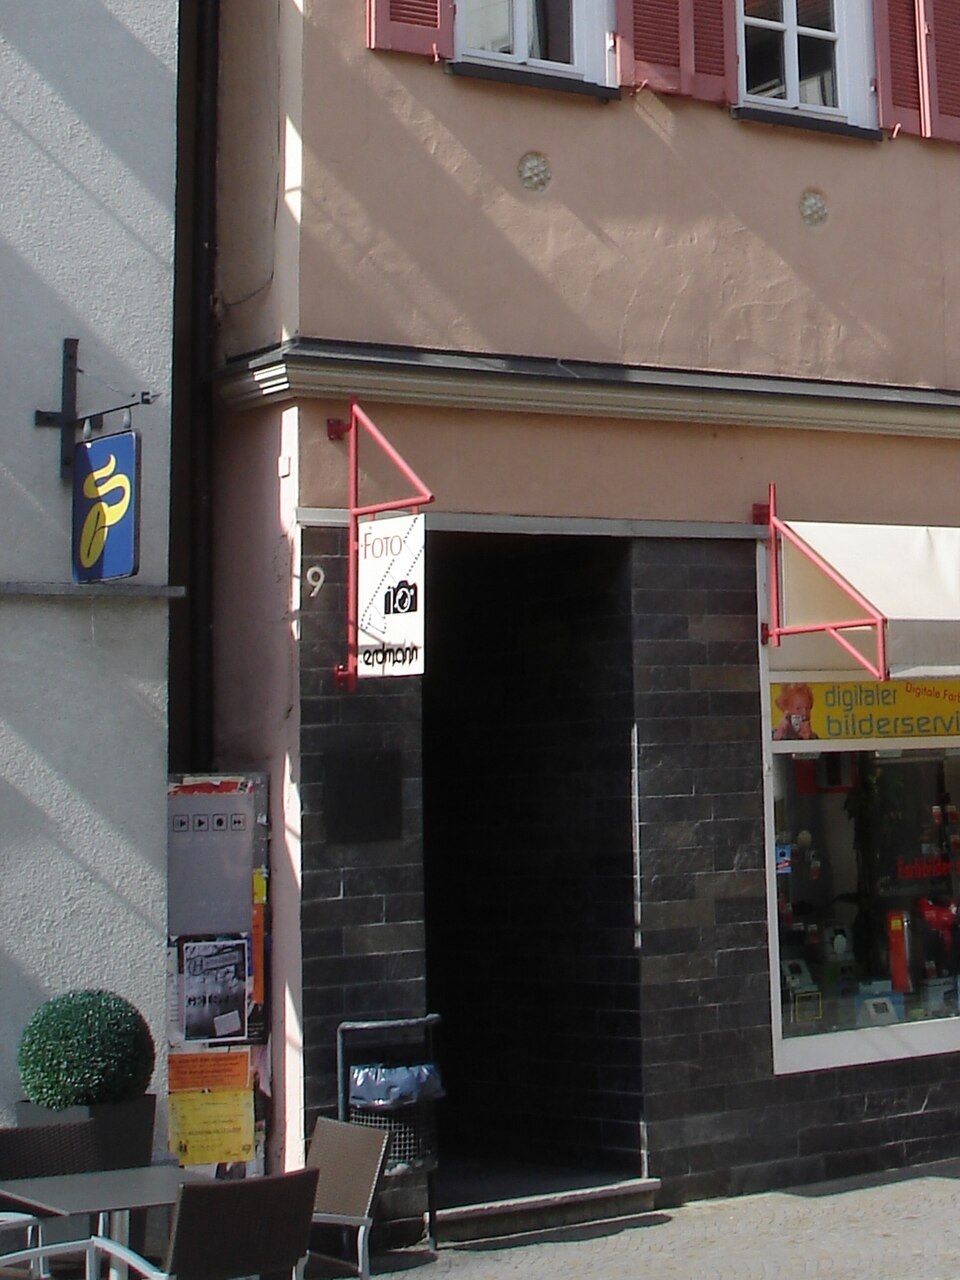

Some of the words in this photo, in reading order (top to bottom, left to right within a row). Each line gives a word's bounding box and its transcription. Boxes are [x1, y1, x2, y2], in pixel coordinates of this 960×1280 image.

[306, 566, 325, 598] 9
[363, 642, 418, 668] erdmann
[824, 684, 898, 712] digitaler
[905, 682, 941, 699] Digitale
